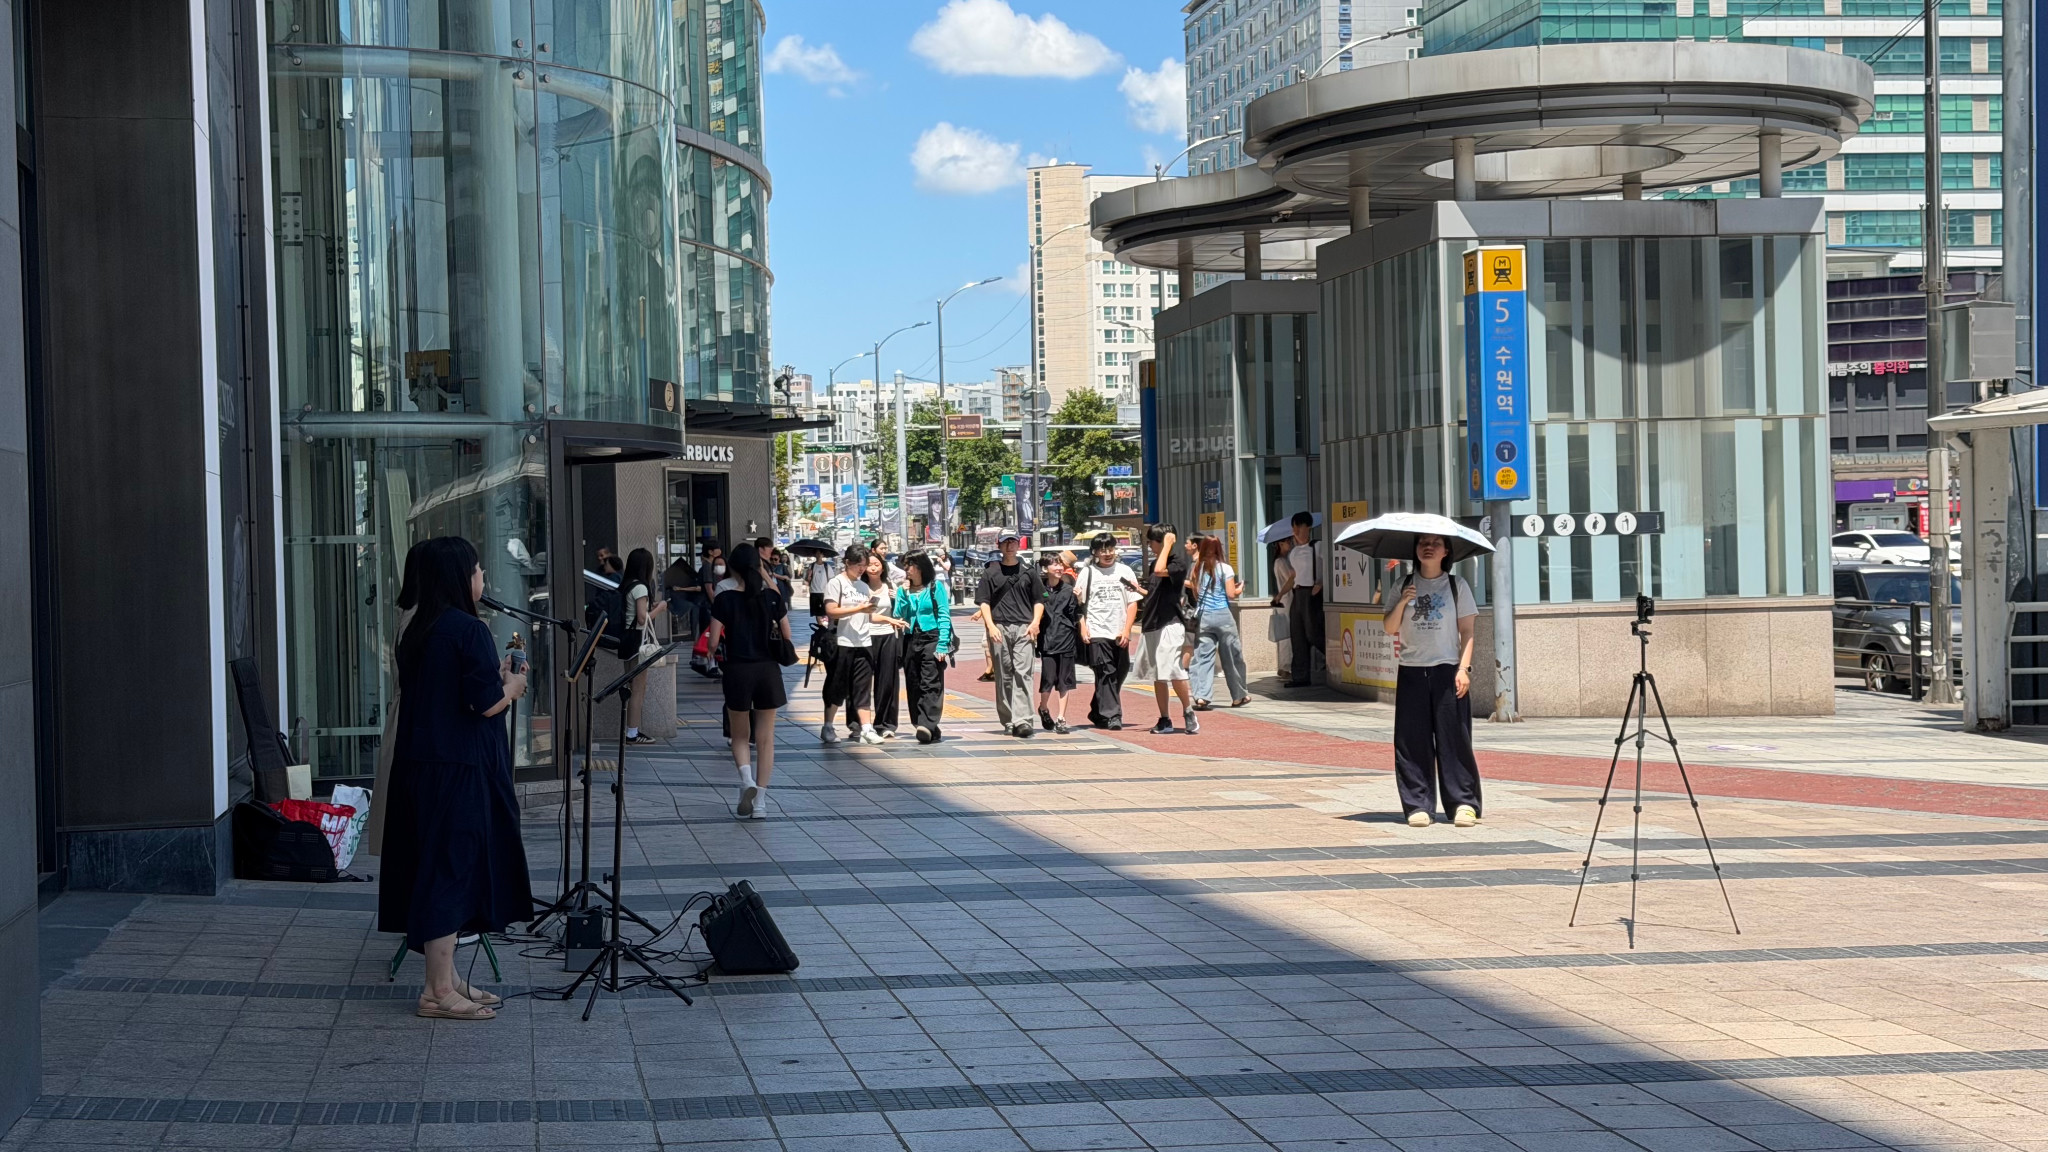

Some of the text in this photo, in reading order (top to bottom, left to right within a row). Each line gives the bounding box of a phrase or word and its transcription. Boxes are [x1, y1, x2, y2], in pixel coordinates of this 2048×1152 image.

[1495, 298, 1510, 323] 5
[1495, 345, 1514, 416] 수원역
[673, 444, 734, 462] RBUCKS
[1502, 448, 1509, 460] 1
